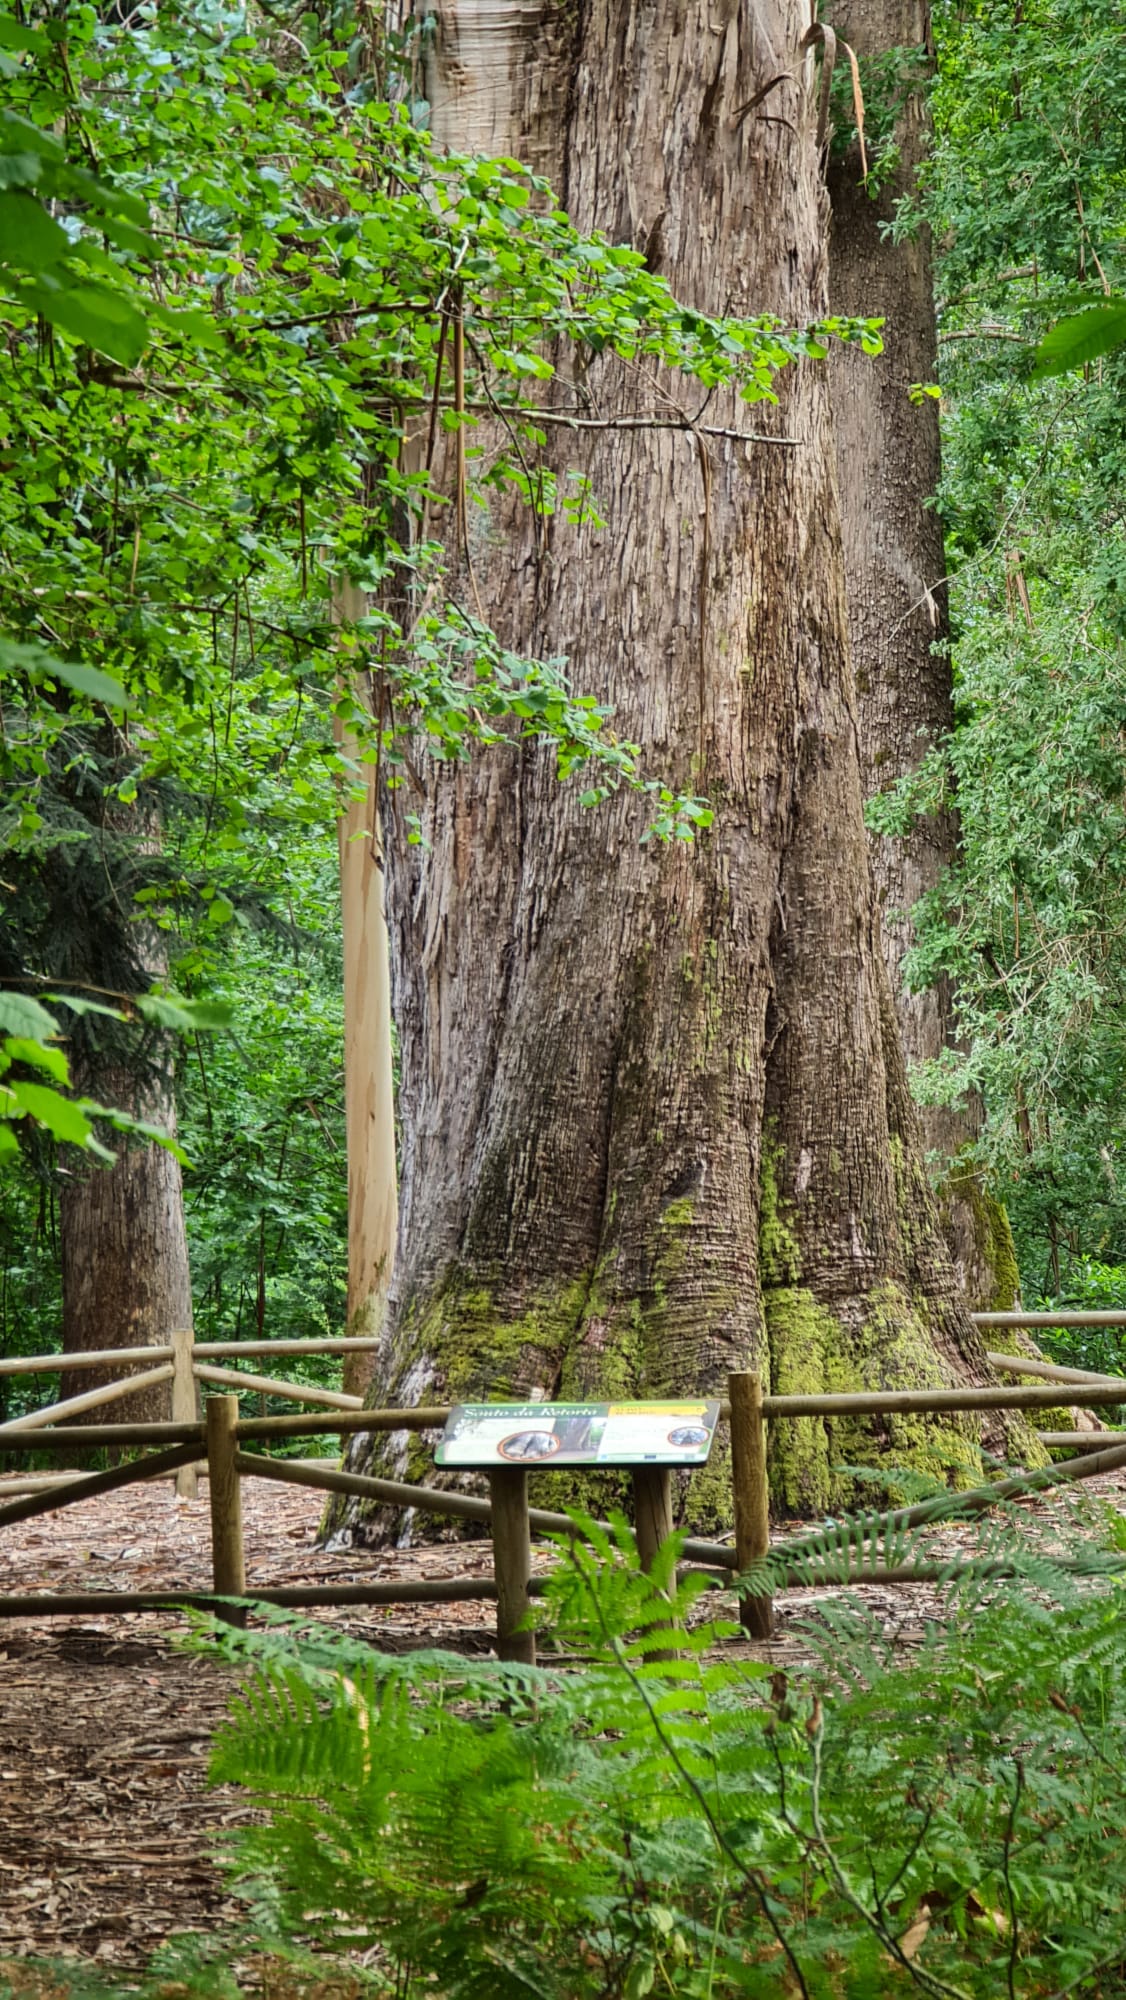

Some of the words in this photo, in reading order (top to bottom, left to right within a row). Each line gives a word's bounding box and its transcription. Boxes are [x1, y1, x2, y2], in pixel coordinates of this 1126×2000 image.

[464, 1408, 509, 1417] Souto
[513, 1406, 533, 1416] da
[540, 1407, 598, 1416] Retorta
